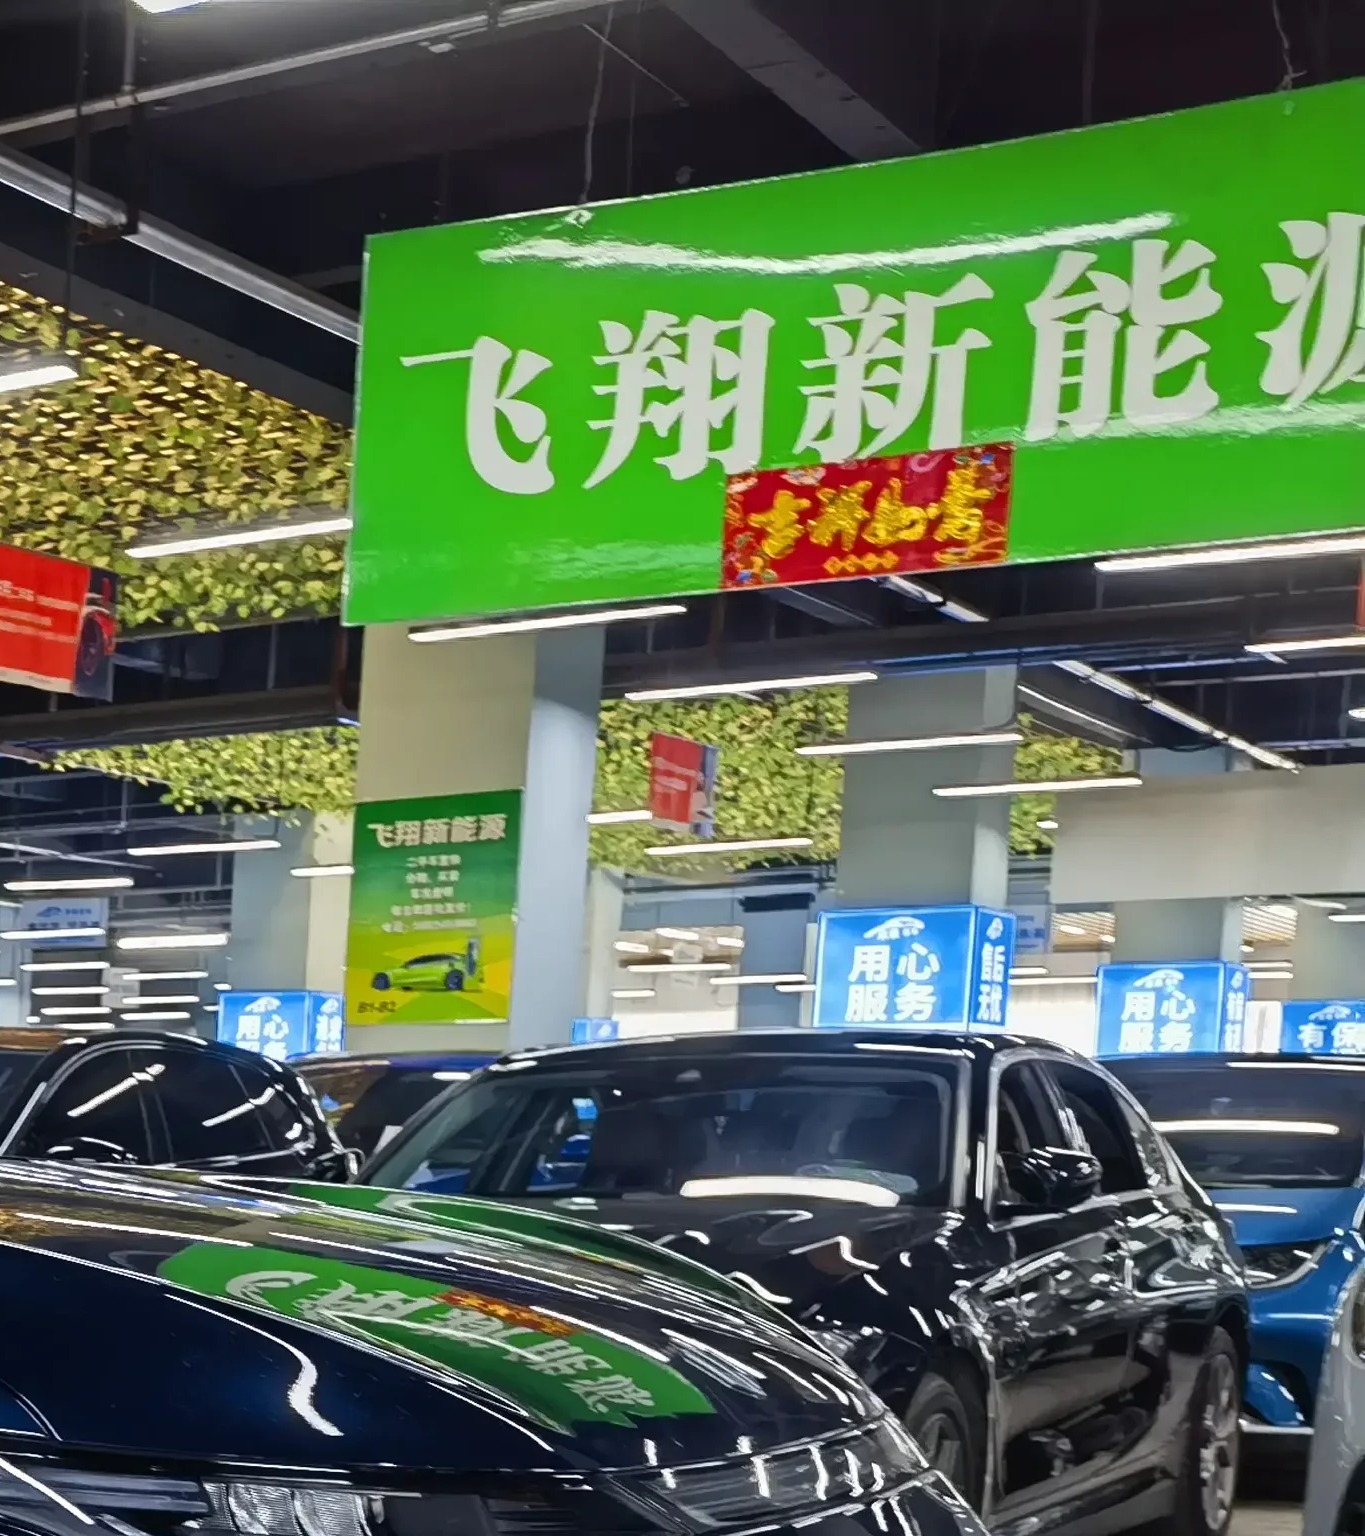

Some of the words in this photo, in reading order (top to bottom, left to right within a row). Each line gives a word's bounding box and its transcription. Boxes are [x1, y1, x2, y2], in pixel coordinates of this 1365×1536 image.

[747, 462, 993, 559] 吉祥如意
[367, 813, 508, 849] 飞翔新能源
[848, 942, 941, 982] 用心
[845, 983, 937, 1022] 服务
[1121, 990, 1196, 1021] 用心
[236, 1014, 289, 1040] 用心
[1118, 1021, 1193, 1052] 服务
